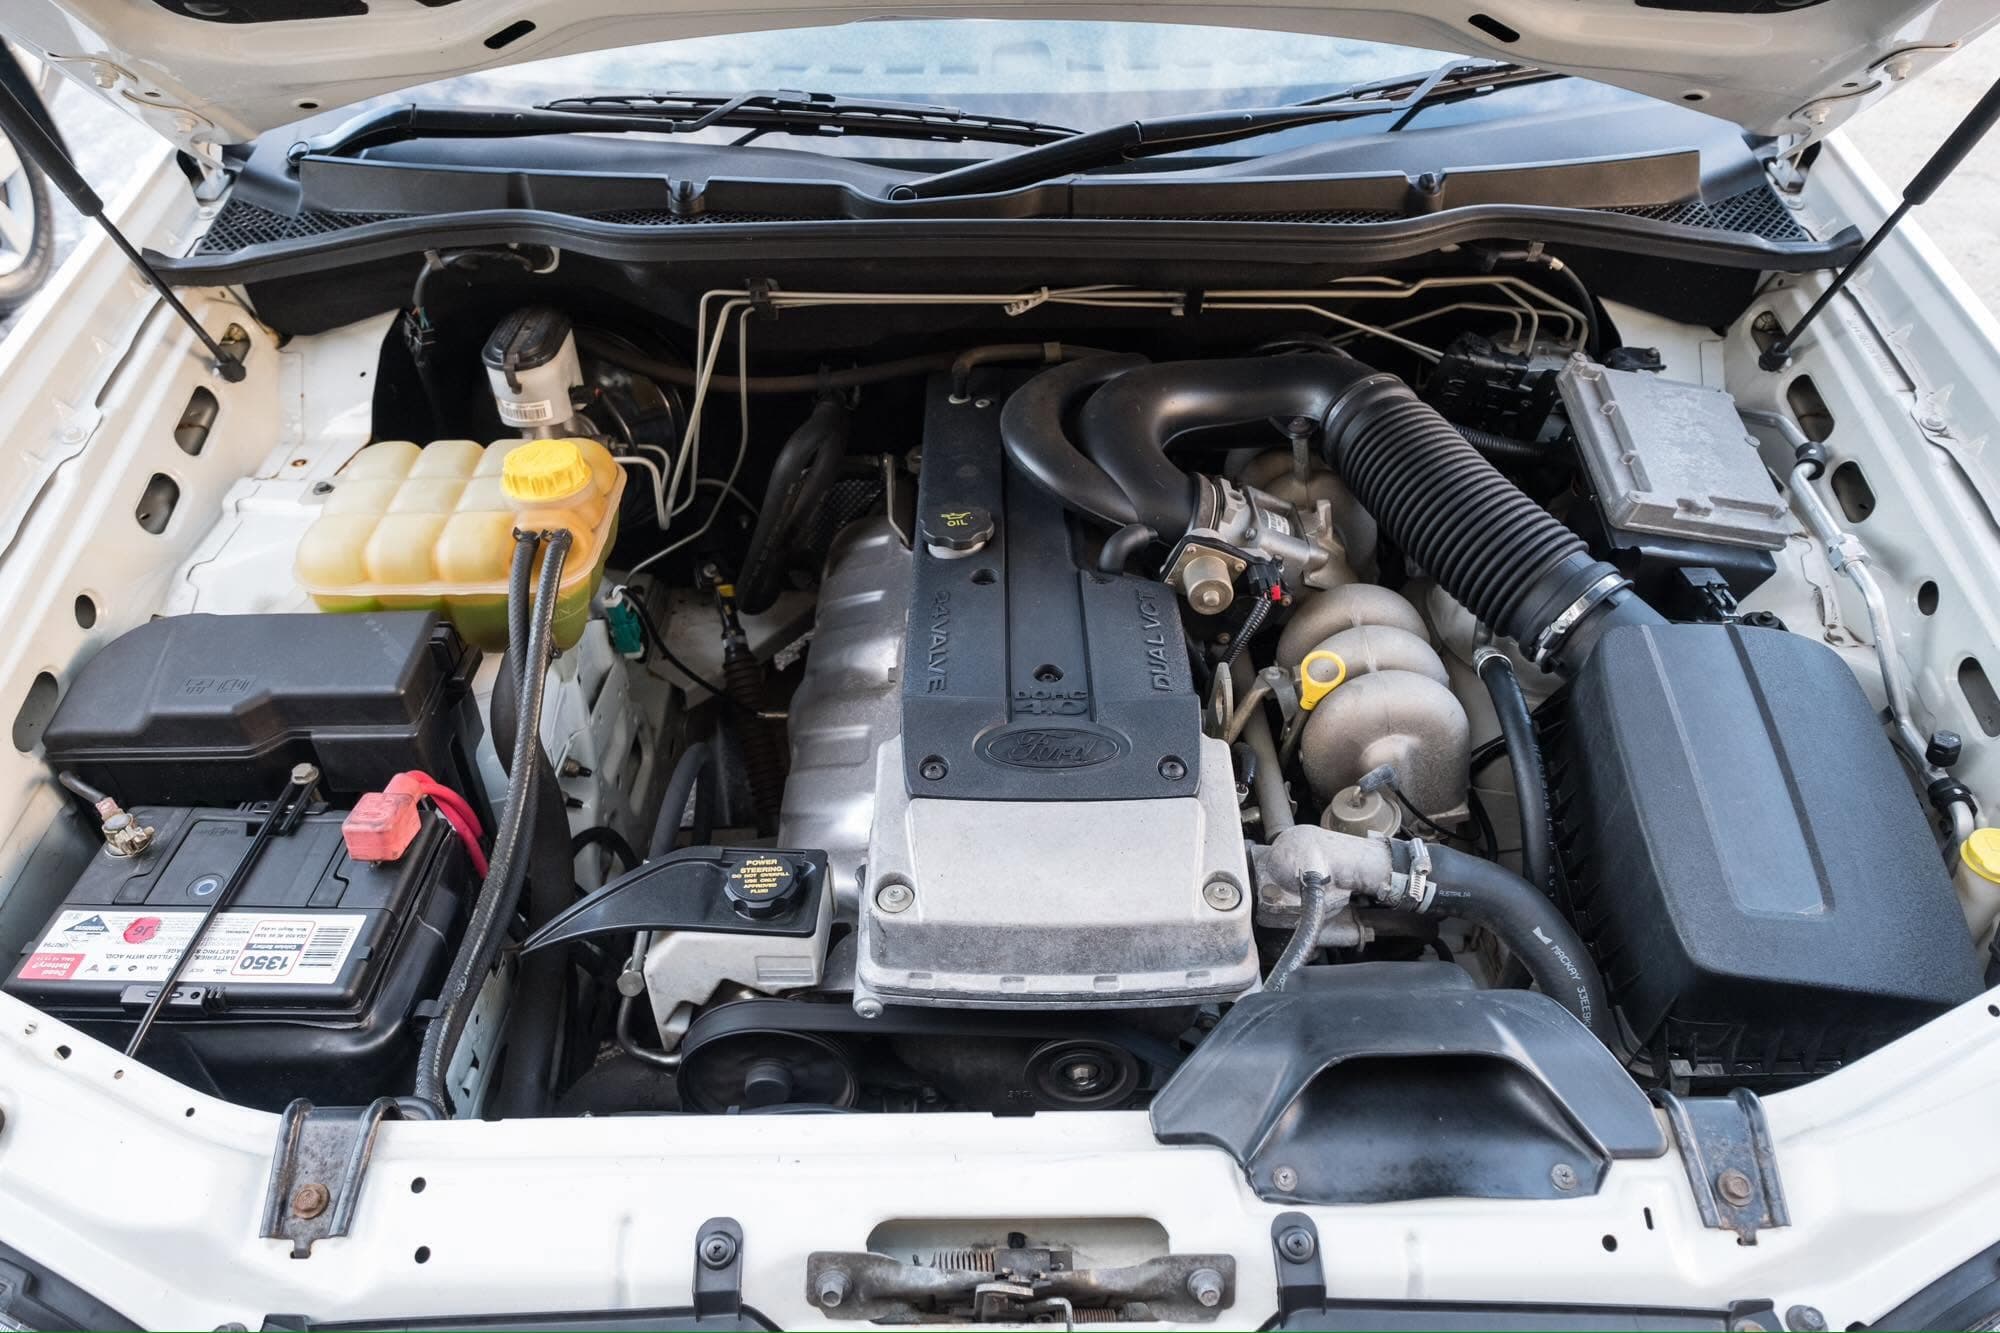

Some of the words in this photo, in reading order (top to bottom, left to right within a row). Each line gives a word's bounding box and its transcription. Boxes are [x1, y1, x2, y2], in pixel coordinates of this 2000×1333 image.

[947, 519, 969, 527] OIL
[1137, 589, 1161, 630] VCT
[1148, 634, 1171, 692] DUAL
[1008, 731, 1099, 763] Ford
[740, 866, 783, 874] STEERING
[32, 961, 71, 971] Battery?
[239, 955, 289, 971] 1350
[1551, 945, 1582, 980] MACKAY
[41, 968, 67, 977] Dead
